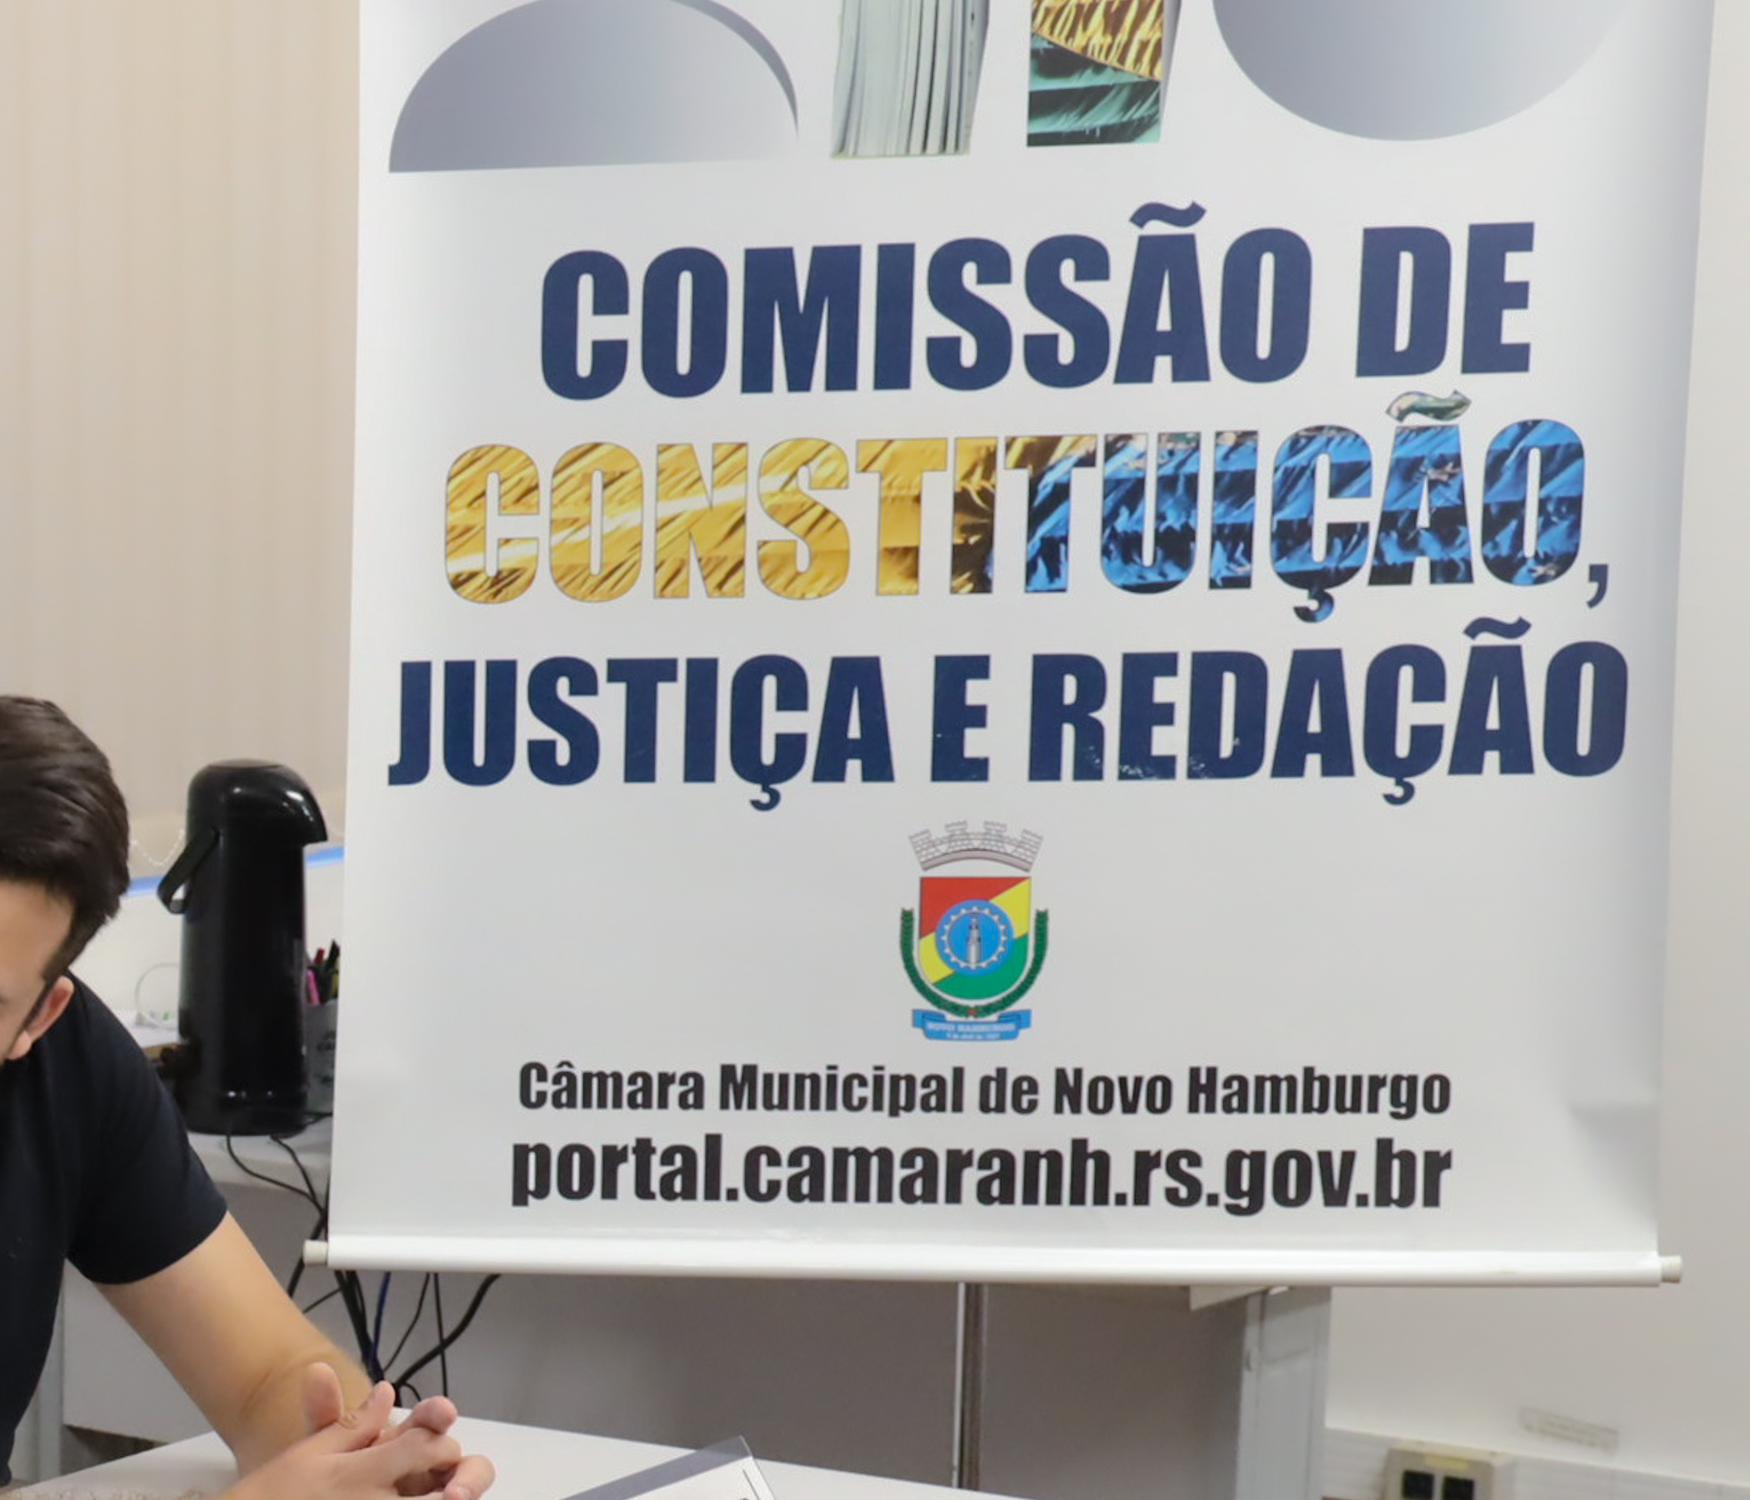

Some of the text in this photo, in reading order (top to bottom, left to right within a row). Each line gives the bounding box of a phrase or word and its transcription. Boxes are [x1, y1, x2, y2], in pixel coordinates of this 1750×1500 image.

[541, 202, 1535, 401] COMISSÃO DE
[443, 389, 1610, 623] CONSTITUIÇÃO,
[388, 616, 1629, 812] JUSTIÇA E REDAÇÃO
[511, 1132, 1453, 1217] portal.camaranh.rs.gov.br
[518, 1060, 1452, 1120] Câmara Municipal de Novo Hamburgo
